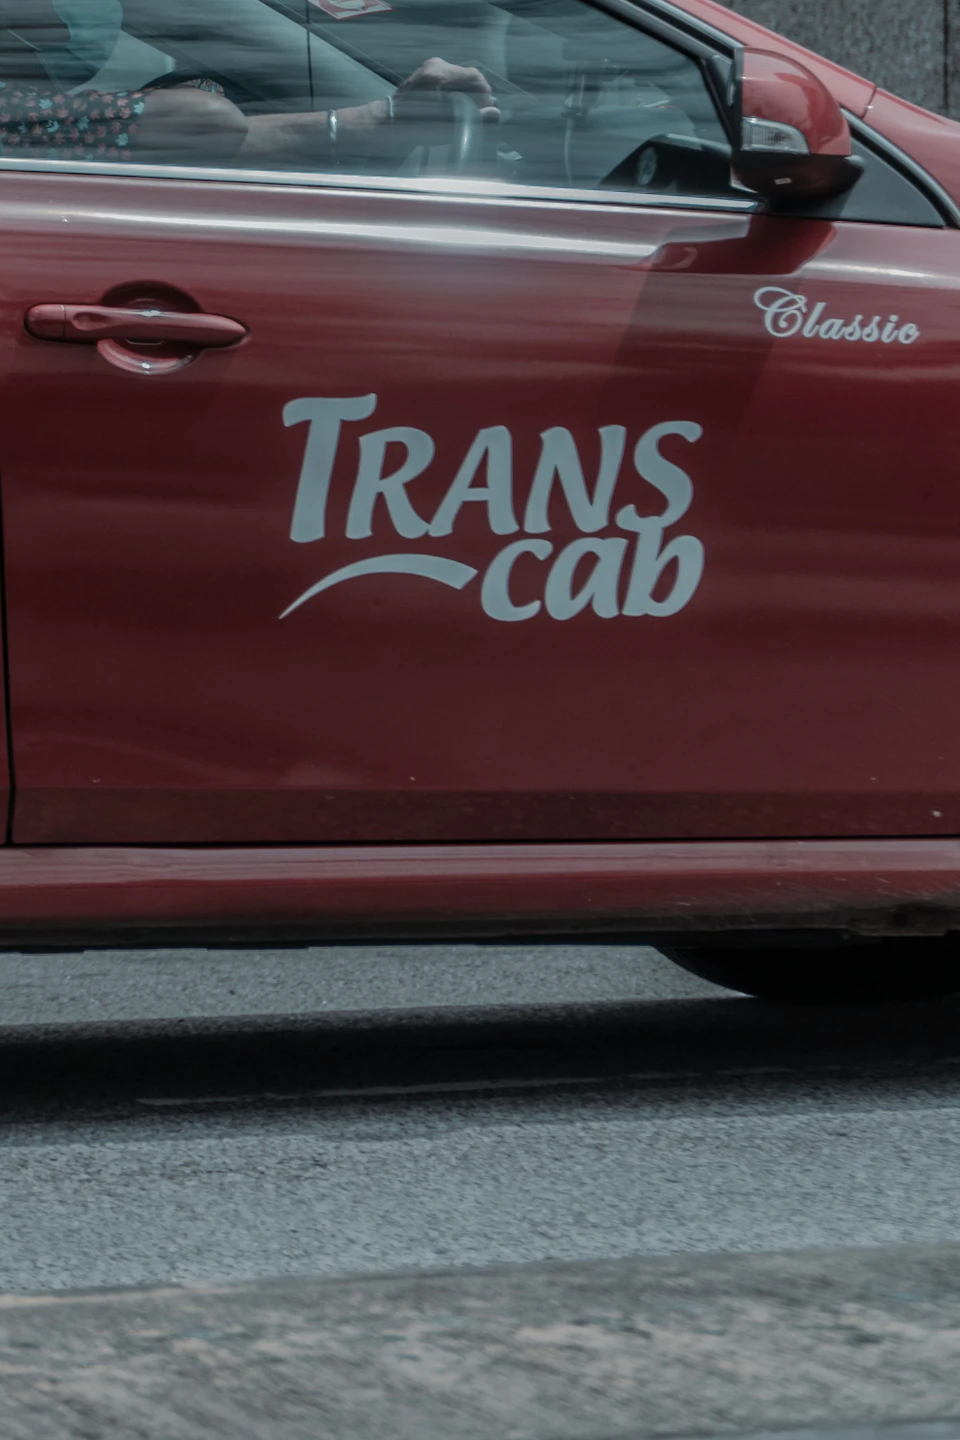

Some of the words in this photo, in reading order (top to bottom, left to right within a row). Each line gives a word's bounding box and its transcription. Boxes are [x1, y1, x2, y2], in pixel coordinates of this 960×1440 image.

[754, 286, 921, 345] Classic
[282, 393, 704, 543] TRANS
[481, 504, 705, 622] cab
